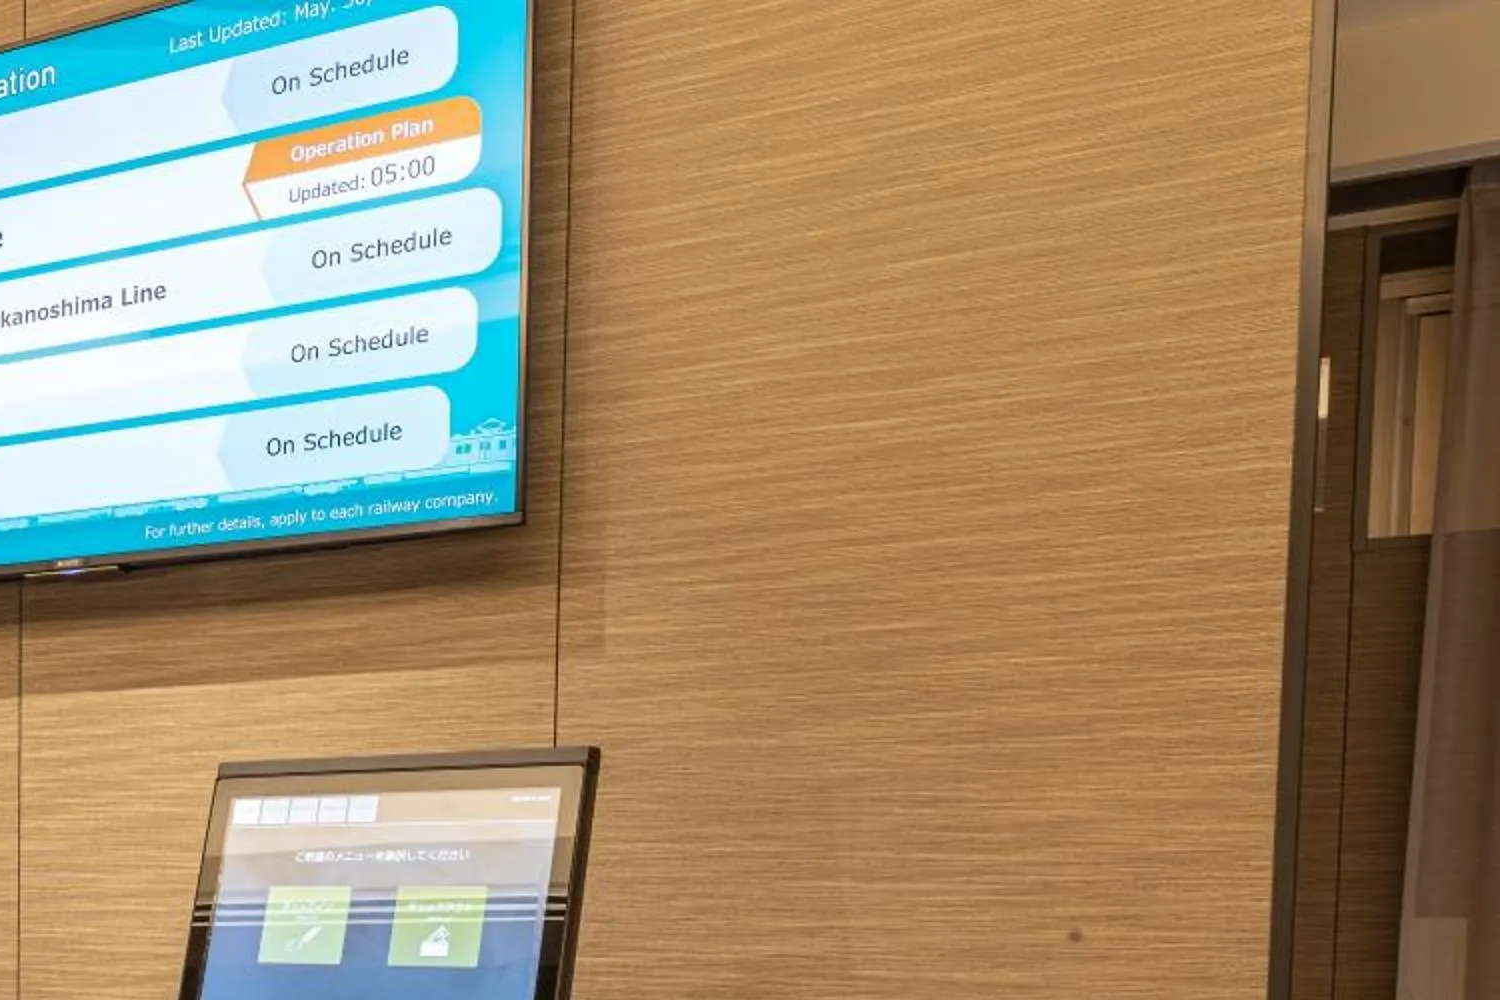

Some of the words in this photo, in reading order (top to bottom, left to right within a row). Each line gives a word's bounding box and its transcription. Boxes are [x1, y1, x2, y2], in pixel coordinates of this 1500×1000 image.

[169, 32, 203, 54] Last
[209, 12, 287, 43] Updated:
[272, 73, 299, 95] On
[309, 47, 409, 86] Schedule
[290, 129, 384, 163] Operation
[392, 118, 433, 141] Plan
[289, 176, 365, 204] Updated:
[371, 155, 435, 188] 05:00
[311, 248, 341, 269] On
[350, 228, 452, 263] Schedule
[121, 283, 167, 306] Line
[290, 343, 320, 364] On
[329, 326, 430, 359] Schedule
[266, 436, 295, 457] On
[304, 422, 403, 452] Schedule
[145, 524, 165, 540] For
[169, 519, 214, 538] further
[217, 513, 266, 533] details,
[270, 509, 306, 528] apply
[311, 506, 325, 521] to
[330, 502, 363, 520] each
[367, 495, 420, 517] railway
[425, 491, 495, 510] company.
